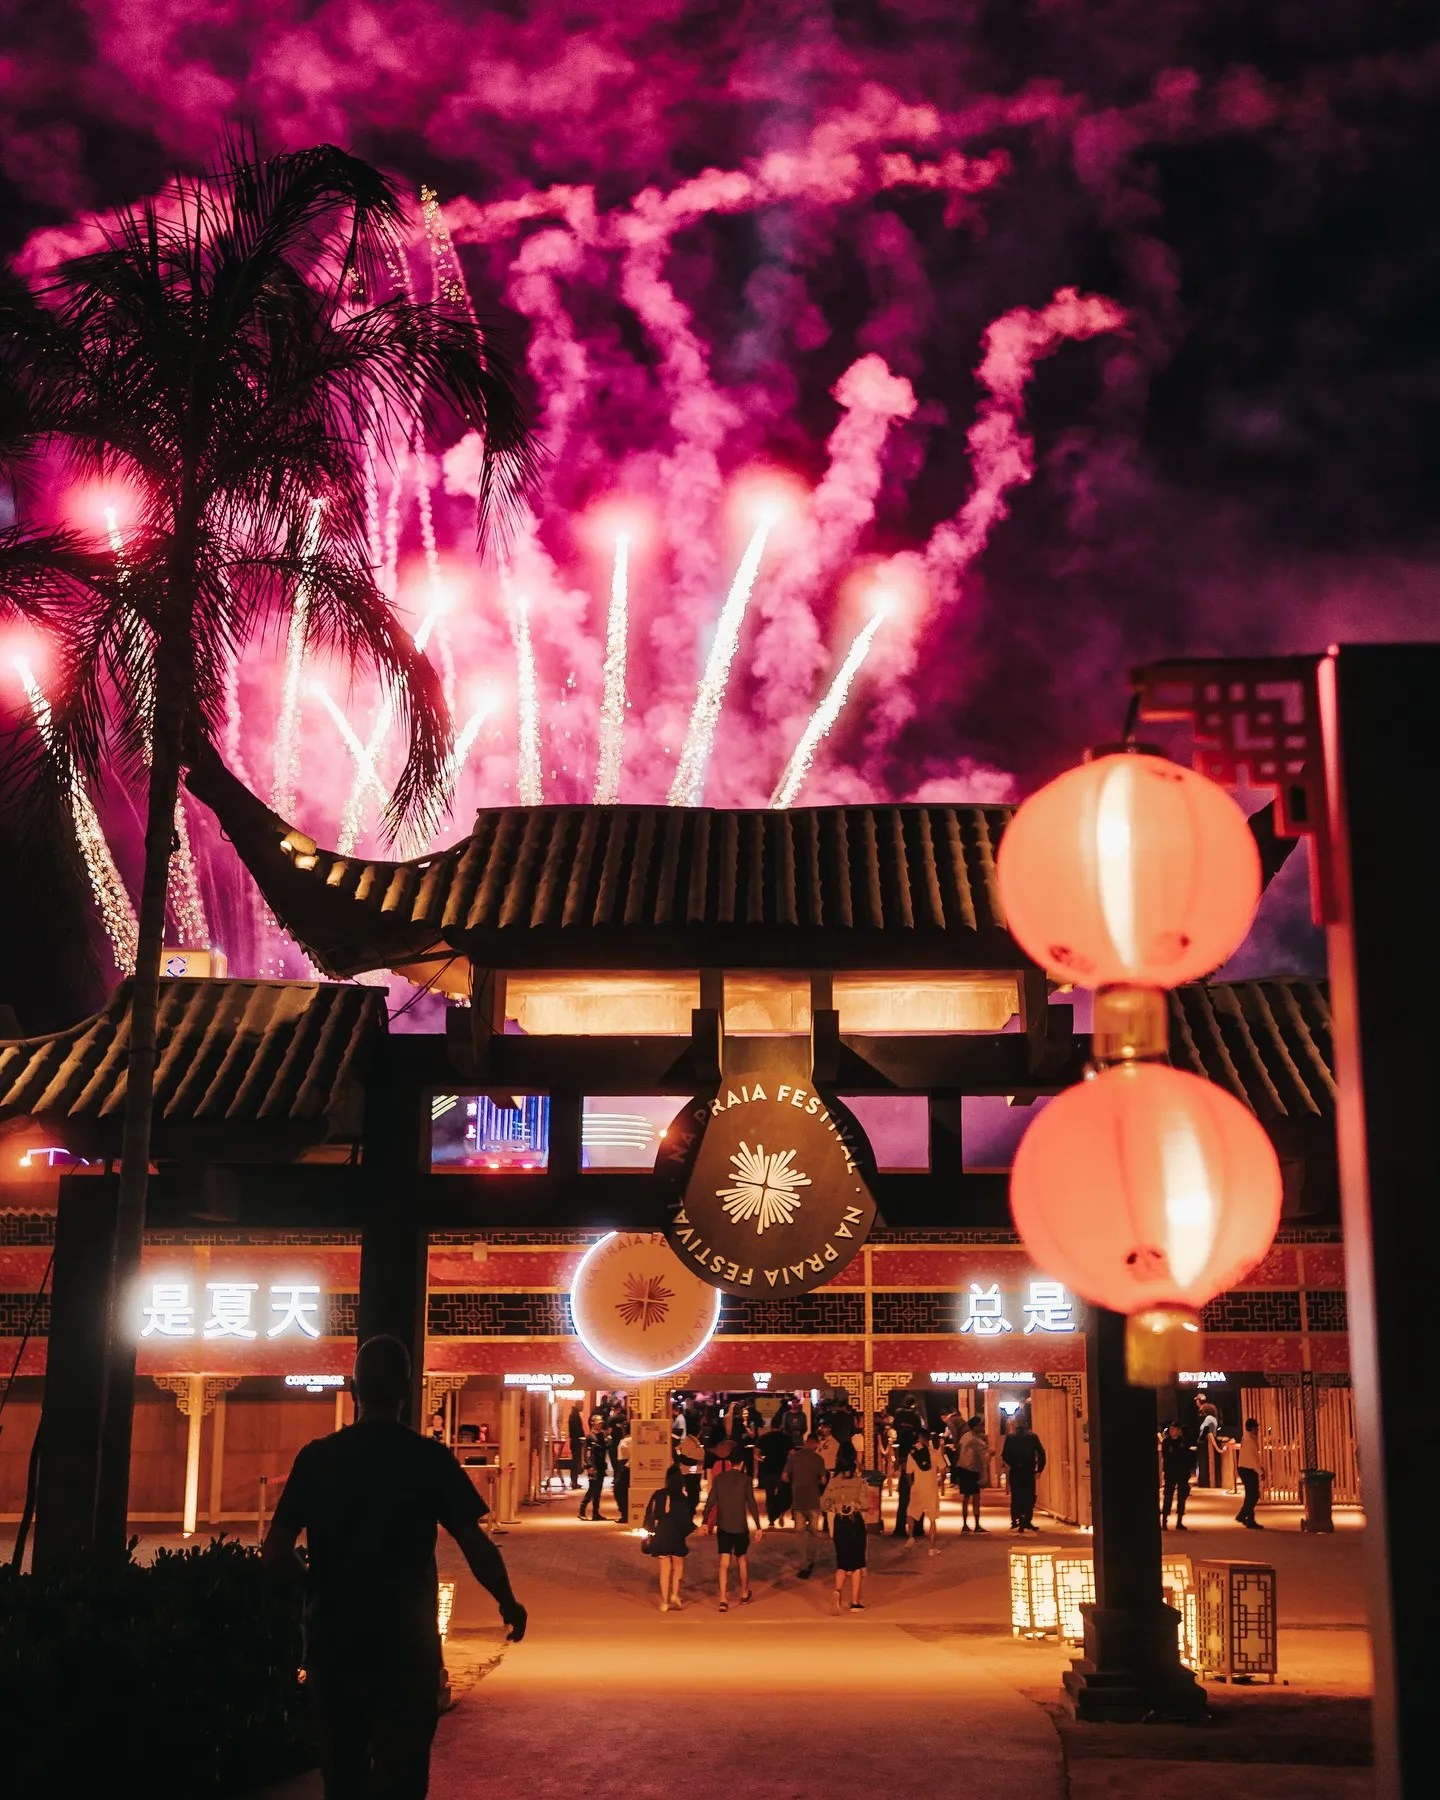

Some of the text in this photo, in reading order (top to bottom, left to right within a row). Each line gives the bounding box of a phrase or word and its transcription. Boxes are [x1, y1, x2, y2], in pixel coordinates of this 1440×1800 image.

[693, 1083, 768, 1126] PRAIA
[777, 1084, 863, 1175] FESTIVAL
[667, 1196, 864, 1287] NA PRAIA FESTIVAL
[141, 1283, 320, 1338] 是夏天
[960, 1282, 1075, 1334] 总是
[753, 1372, 771, 1382] VIP
[930, 1372, 1036, 1382] VIP BANCO DO BRASIL
[1178, 1371, 1226, 1382] ENTRADA
